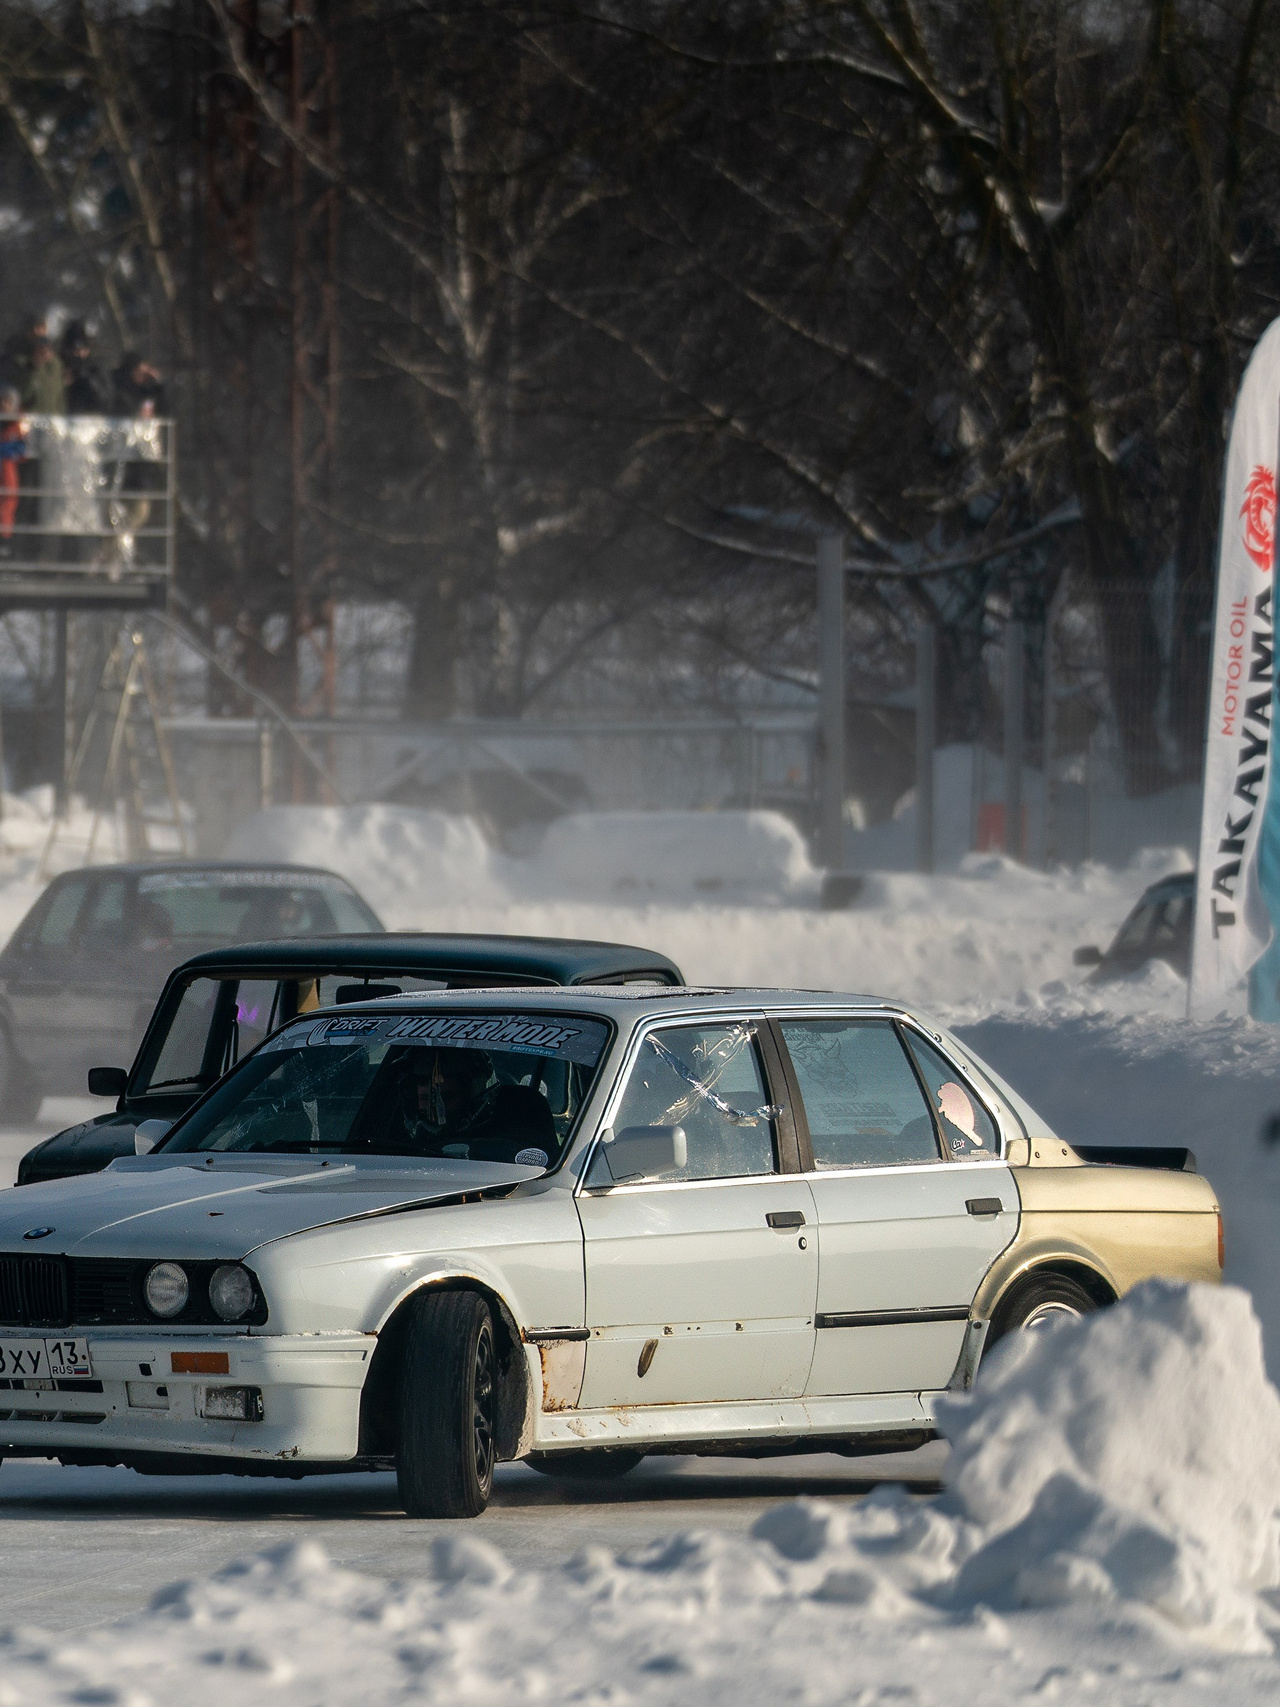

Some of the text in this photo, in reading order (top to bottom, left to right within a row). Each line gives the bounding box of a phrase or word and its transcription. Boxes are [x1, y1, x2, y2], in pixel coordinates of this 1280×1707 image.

[1221, 596, 1248, 736] MOTOR OIL
[1210, 584, 1272, 939] TAKAYAMA
[331, 1019, 389, 1031] DRIFT
[385, 1018, 582, 1049] WINTER MODE
[51, 1341, 78, 1365] 13
[52, 1366, 73, 1375] RUS
